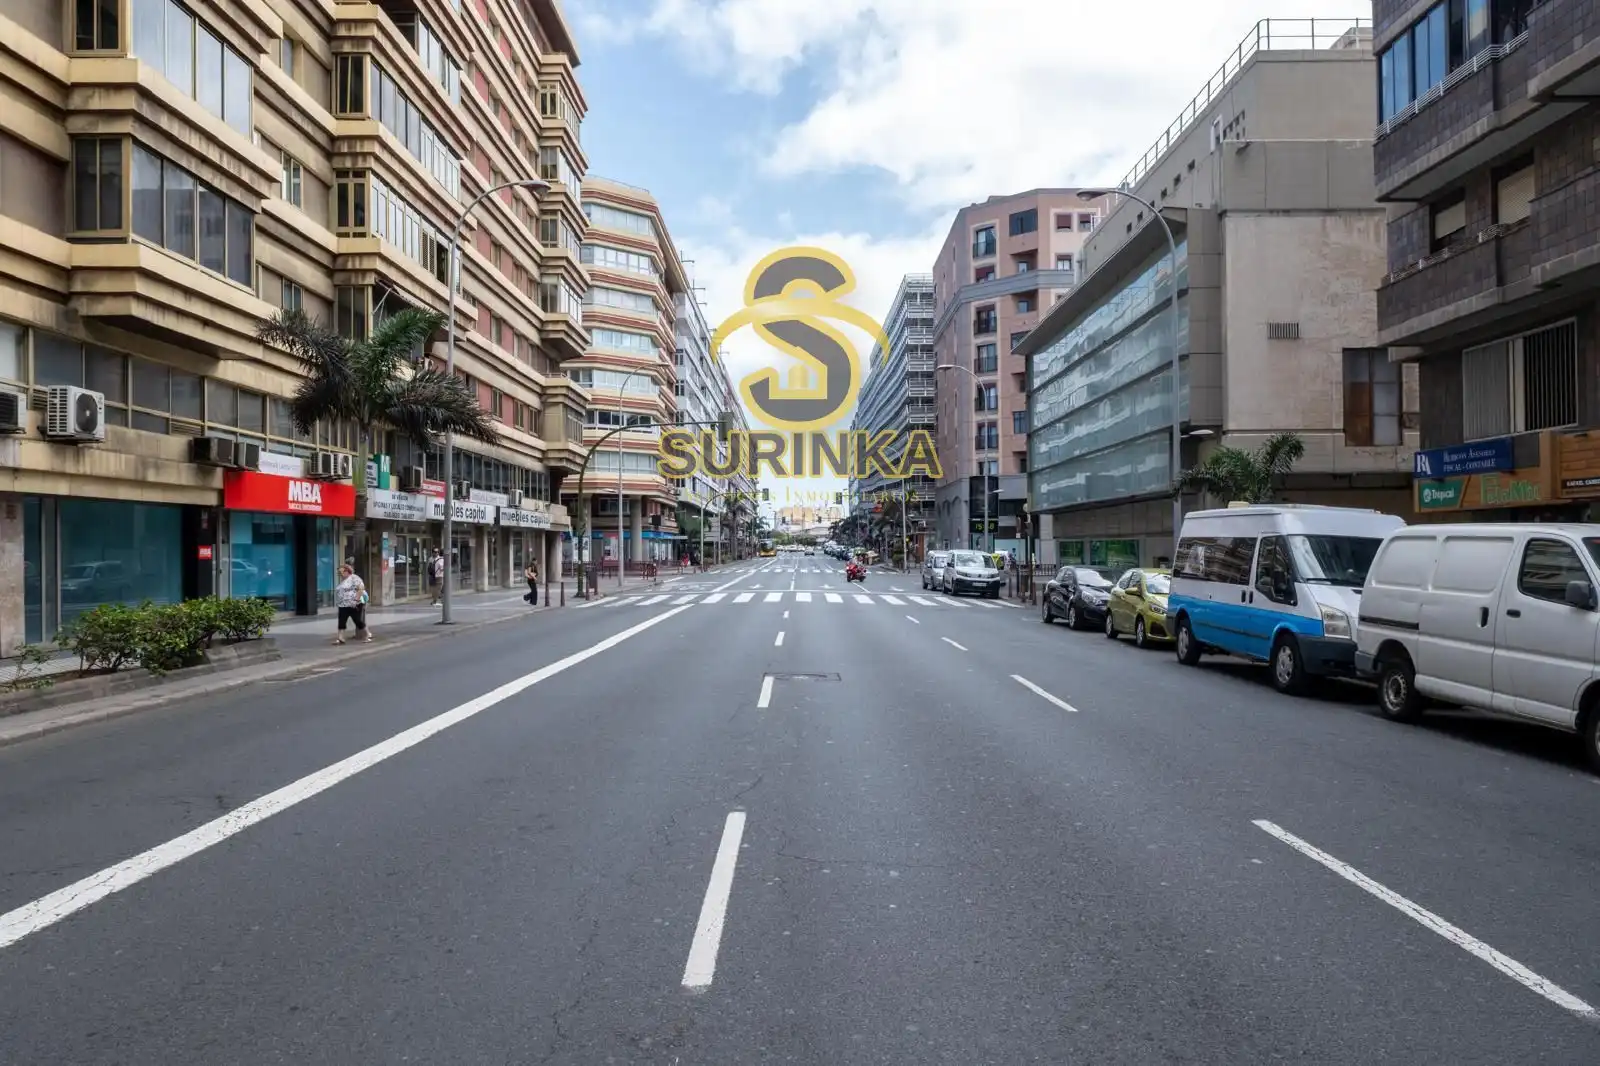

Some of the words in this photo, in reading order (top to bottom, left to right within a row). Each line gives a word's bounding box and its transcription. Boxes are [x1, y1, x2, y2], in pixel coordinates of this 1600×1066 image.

[288, 480, 322, 503] MBA
[433, 502, 464, 518] mubles
[465, 505, 487, 521] capitol
